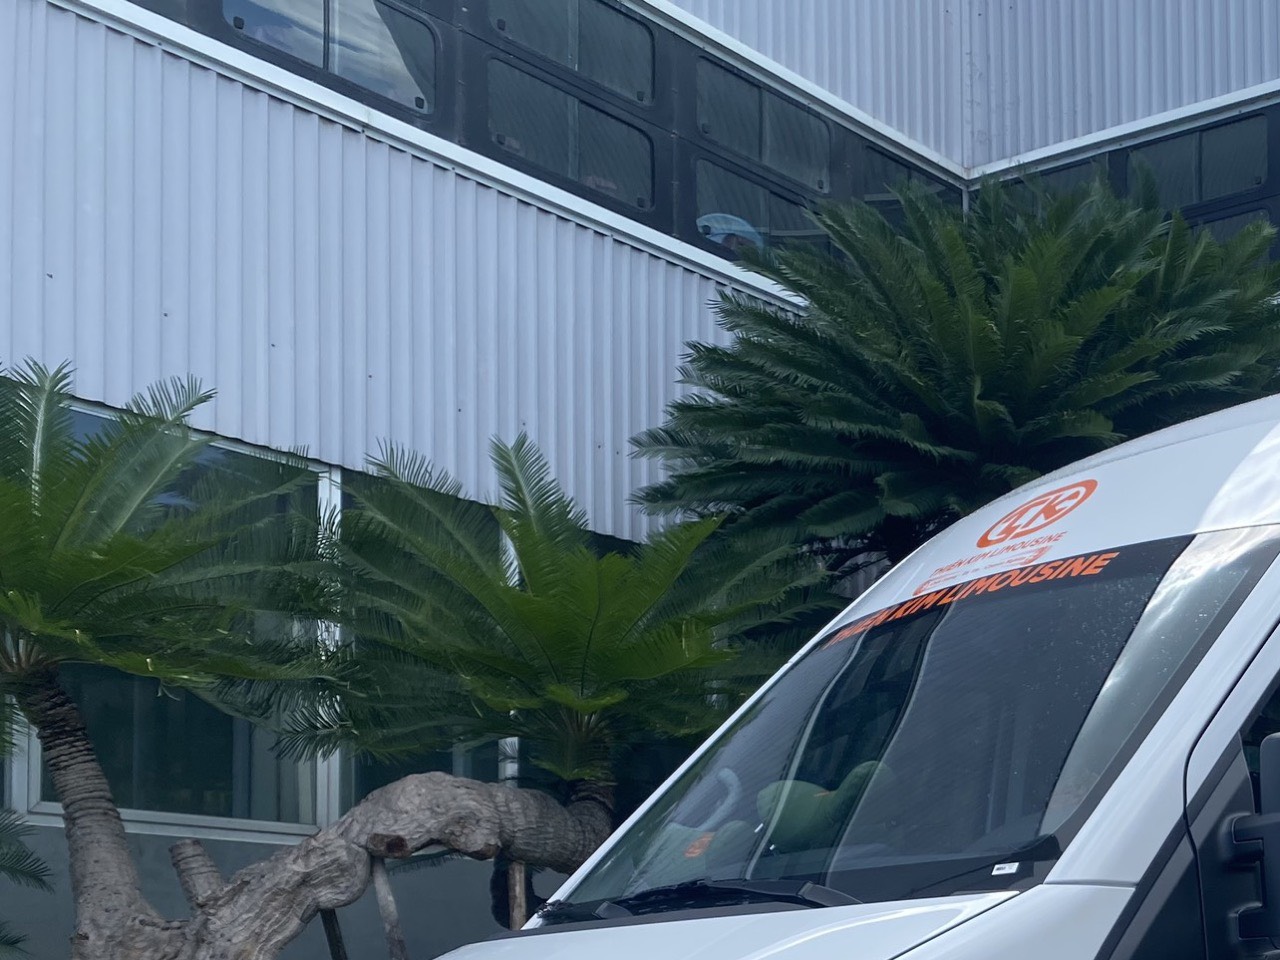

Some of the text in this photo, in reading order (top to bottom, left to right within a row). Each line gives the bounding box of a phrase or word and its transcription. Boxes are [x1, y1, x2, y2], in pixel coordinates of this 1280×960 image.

[987, 531, 1067, 558] LIMOUSINE
[886, 588, 950, 622] KIM
[937, 552, 1120, 605] LIMOUSINE
